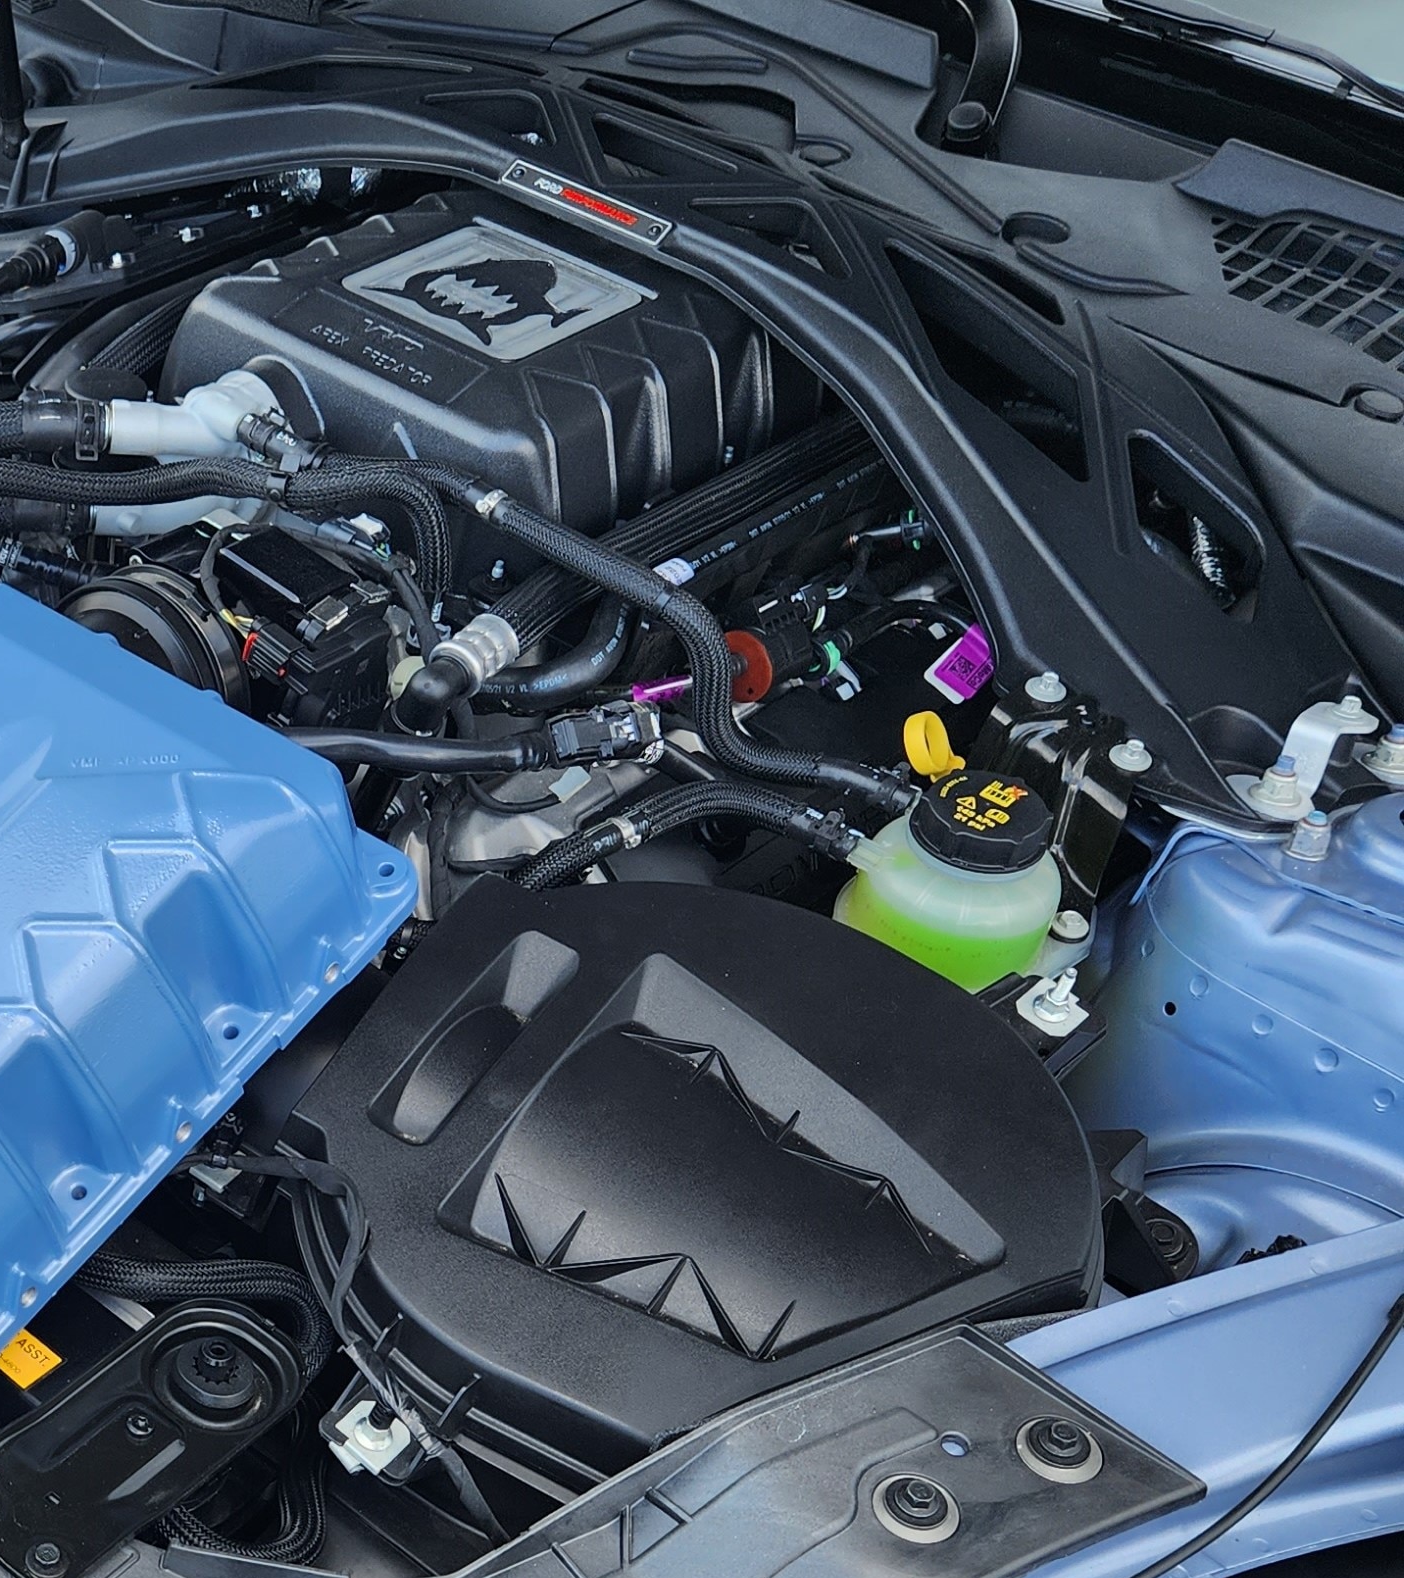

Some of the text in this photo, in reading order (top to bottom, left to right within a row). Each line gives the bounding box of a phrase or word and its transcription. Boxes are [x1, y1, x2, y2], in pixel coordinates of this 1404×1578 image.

[533, 177, 639, 227] FORD PERFORMANCE
[309, 324, 434, 387] APEX PREDATOR
[16, 1338, 51, 1367] ASST.
